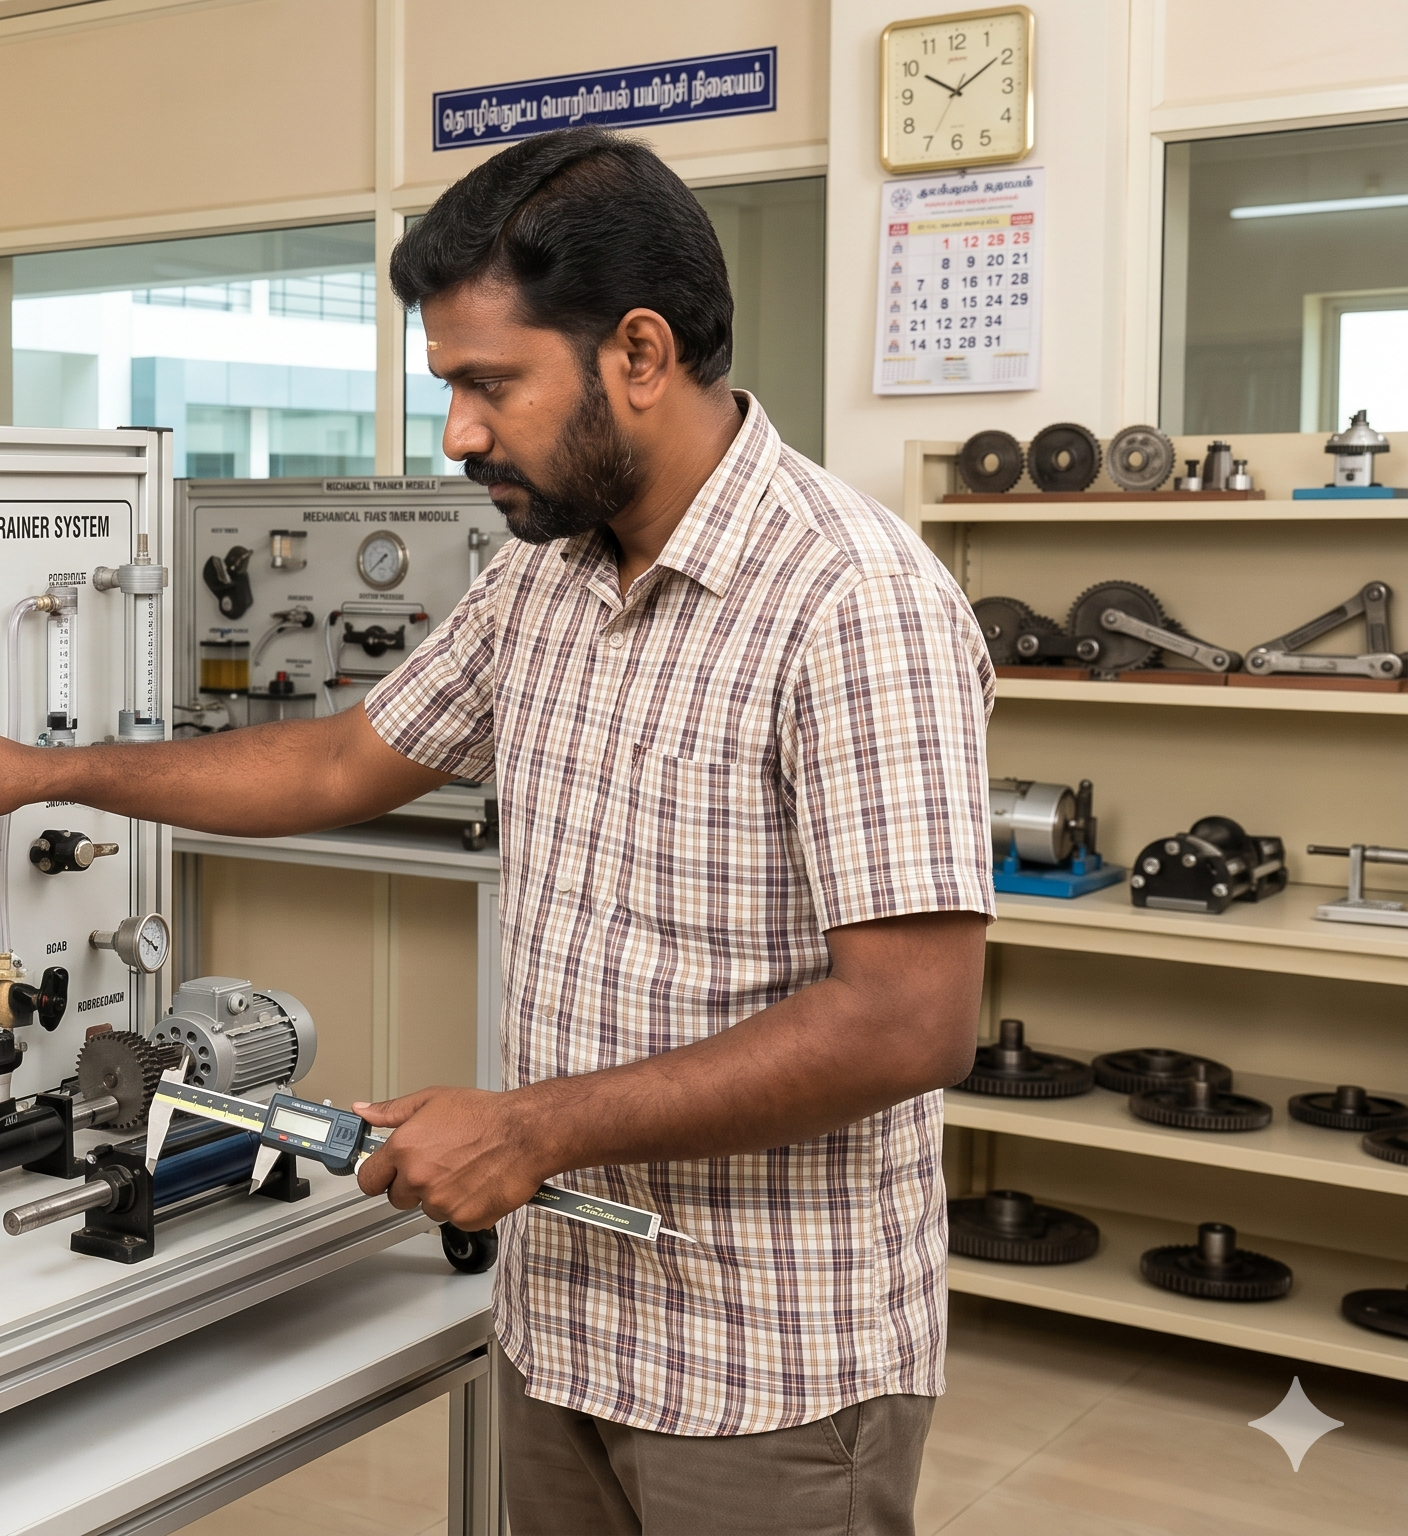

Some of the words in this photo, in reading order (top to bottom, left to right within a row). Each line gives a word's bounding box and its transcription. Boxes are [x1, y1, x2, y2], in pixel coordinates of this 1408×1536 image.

[922, 38, 936, 55] 11
[948, 33, 966, 51] 12
[984, 31, 989, 47] 1
[1001, 48, 1014, 65] 2
[902, 60, 919, 78] 10
[1002, 77, 1014, 94] 3
[443, 97, 537, 138] தொழில்நுட்ப
[541, 80, 631, 124] பொறியியல்
[634, 72, 688, 112] பயிற்சி
[690, 61, 765, 109] நிலையம்
[902, 88, 914, 105] 9
[1000, 107, 1012, 123] 4
[903, 118, 915, 134] 8
[923, 136, 934, 152] 7
[951, 134, 963, 150] 6
[980, 129, 992, 146] 5
[963, 236, 979, 248] 12
[942, 258, 950, 270] 8
[967, 256, 975, 268] 9
[987, 254, 1004, 266] 20
[1012, 252, 1028, 264] 21
[917, 279, 924, 291] 7
[941, 278, 949, 290] 8
[987, 274, 1002, 286] 17
[1011, 272, 1029, 285] 28
[912, 299, 927, 311] 14
[962, 296, 977, 308] 15
[986, 295, 1003, 306] 24
[910, 320, 926, 332] 21
[936, 318, 952, 329] 12
[960, 317, 977, 328] 27
[985, 315, 1002, 327] 34
[910, 339, 926, 351] 14
[936, 338, 951, 349] 13
[959, 337, 976, 348] 28
[984, 336, 1001, 347] 31
[419, 510, 459, 522] MODULE
[54, 515, 110, 538] SYSTEM
